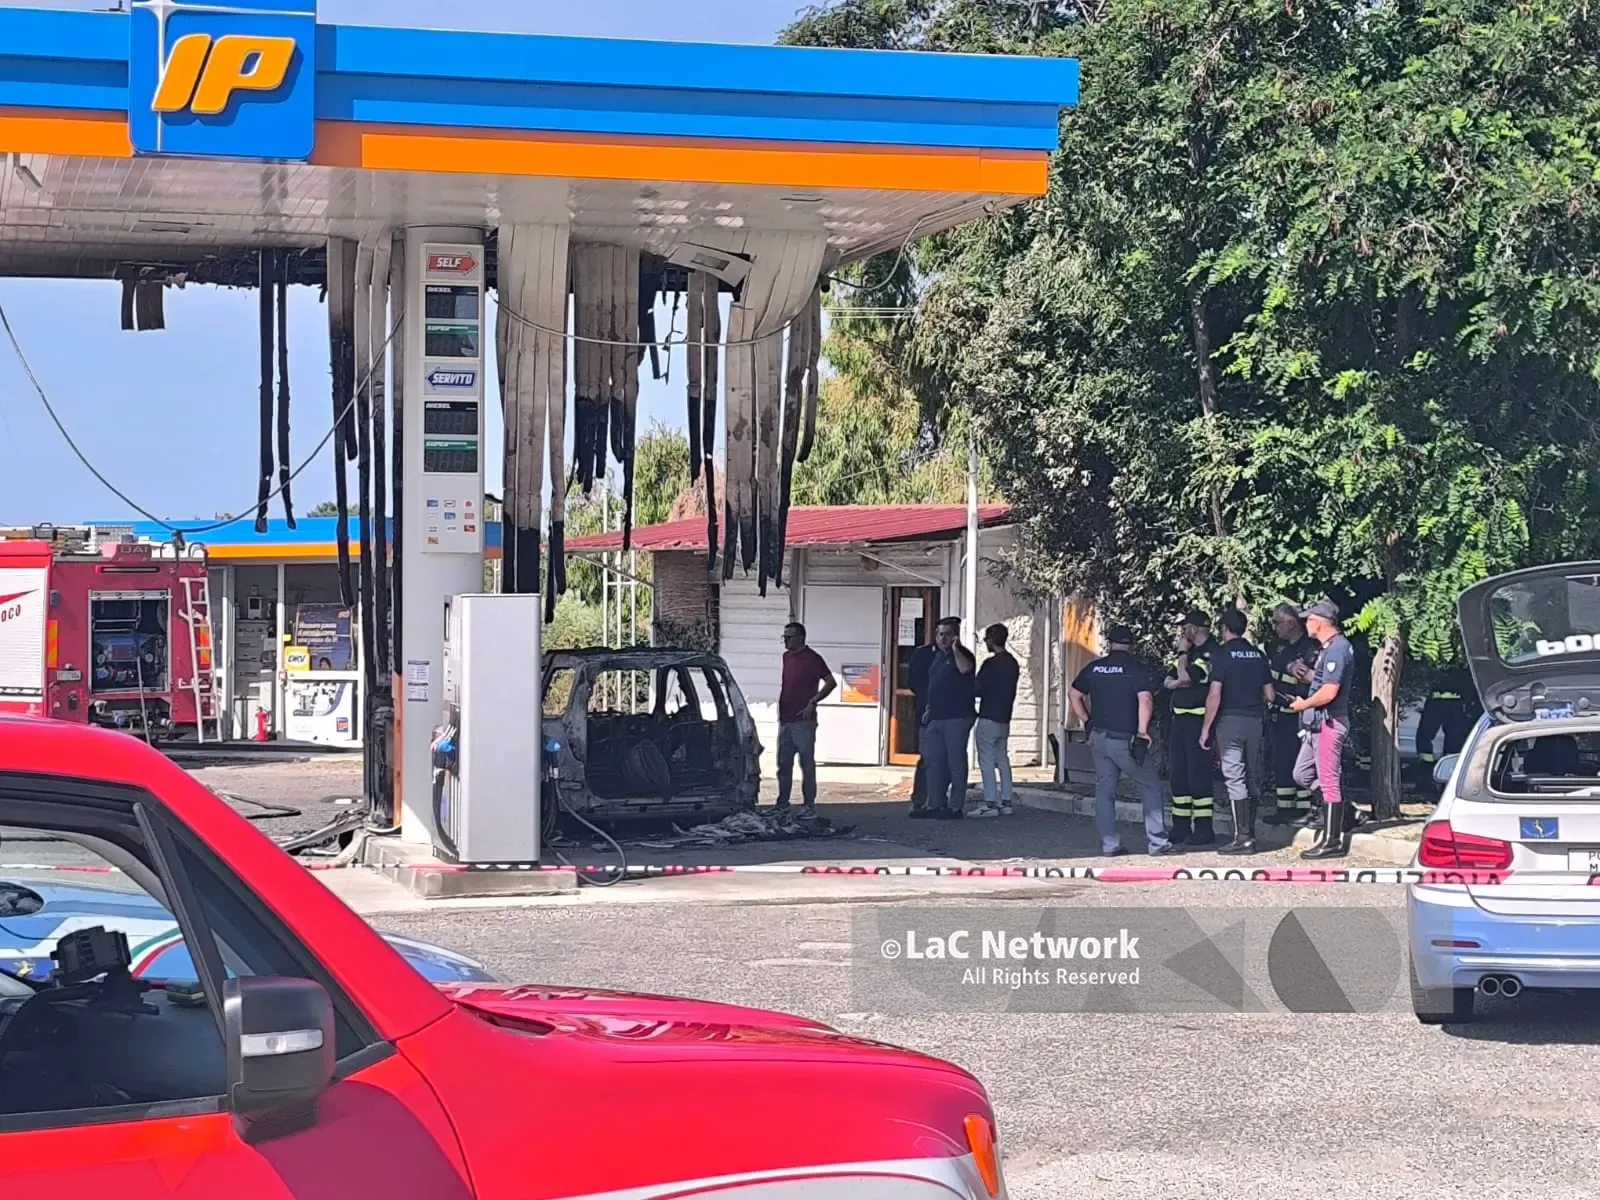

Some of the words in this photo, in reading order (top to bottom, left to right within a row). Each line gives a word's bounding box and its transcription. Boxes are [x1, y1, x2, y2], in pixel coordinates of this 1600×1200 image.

[151, 33, 296, 115] IP
[436, 257, 462, 268] SELF
[432, 373, 473, 385] SERVITO
[287, 654, 306, 664] DKV
[1231, 650, 1261, 660] POLIZIA
[1093, 665, 1124, 674] POLIZIA
